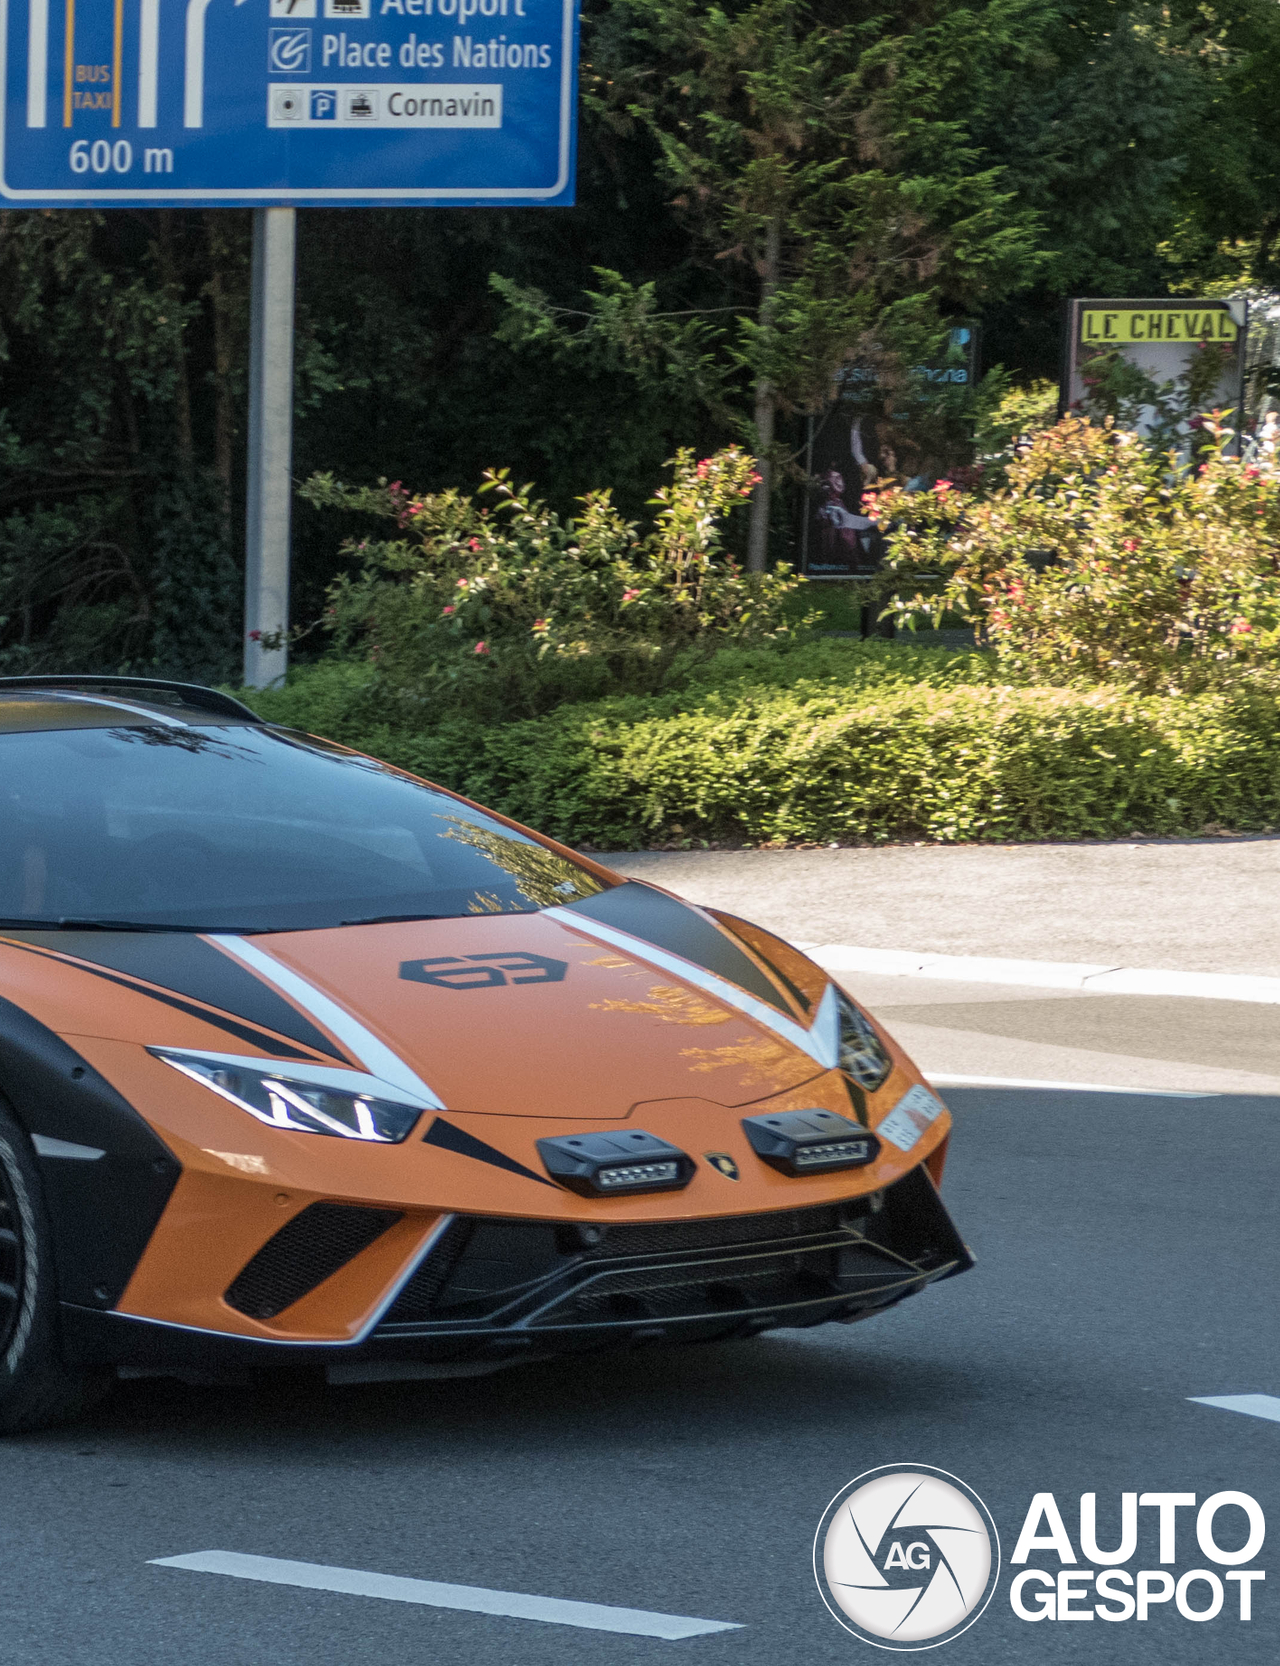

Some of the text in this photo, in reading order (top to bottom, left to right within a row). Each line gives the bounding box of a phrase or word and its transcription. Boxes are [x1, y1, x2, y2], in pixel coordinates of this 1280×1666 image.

[322, 32, 552, 69] Place des Nations
[75, 65, 110, 82] BUS
[73, 92, 113, 109] TAXI
[388, 92, 495, 117] Cornavin
[69, 139, 173, 173] 600 m
[1086, 313, 1233, 340] LE CHEVAL
